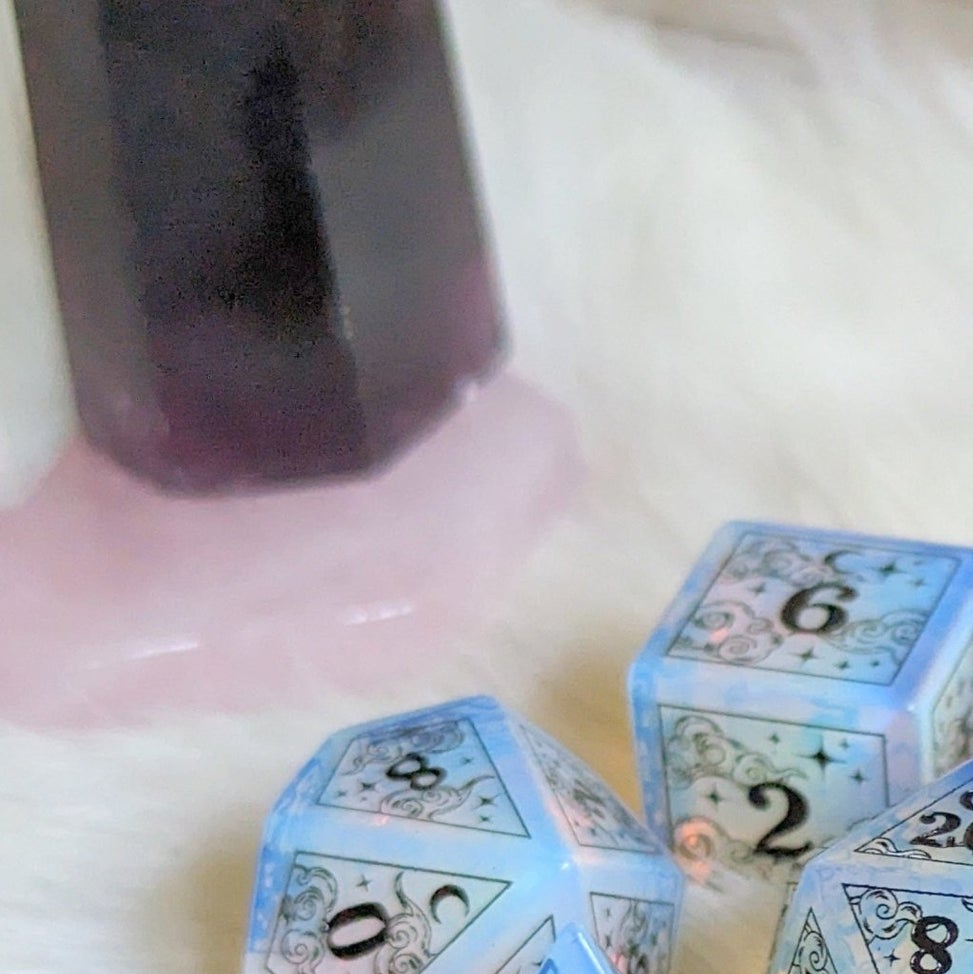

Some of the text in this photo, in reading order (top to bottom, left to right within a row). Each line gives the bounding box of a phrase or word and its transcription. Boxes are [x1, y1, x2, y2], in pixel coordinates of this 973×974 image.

[781, 582, 858, 635] 6
[385, 753, 447, 791] 8
[748, 782, 812, 857] 2
[326, 902, 388, 960] 0
